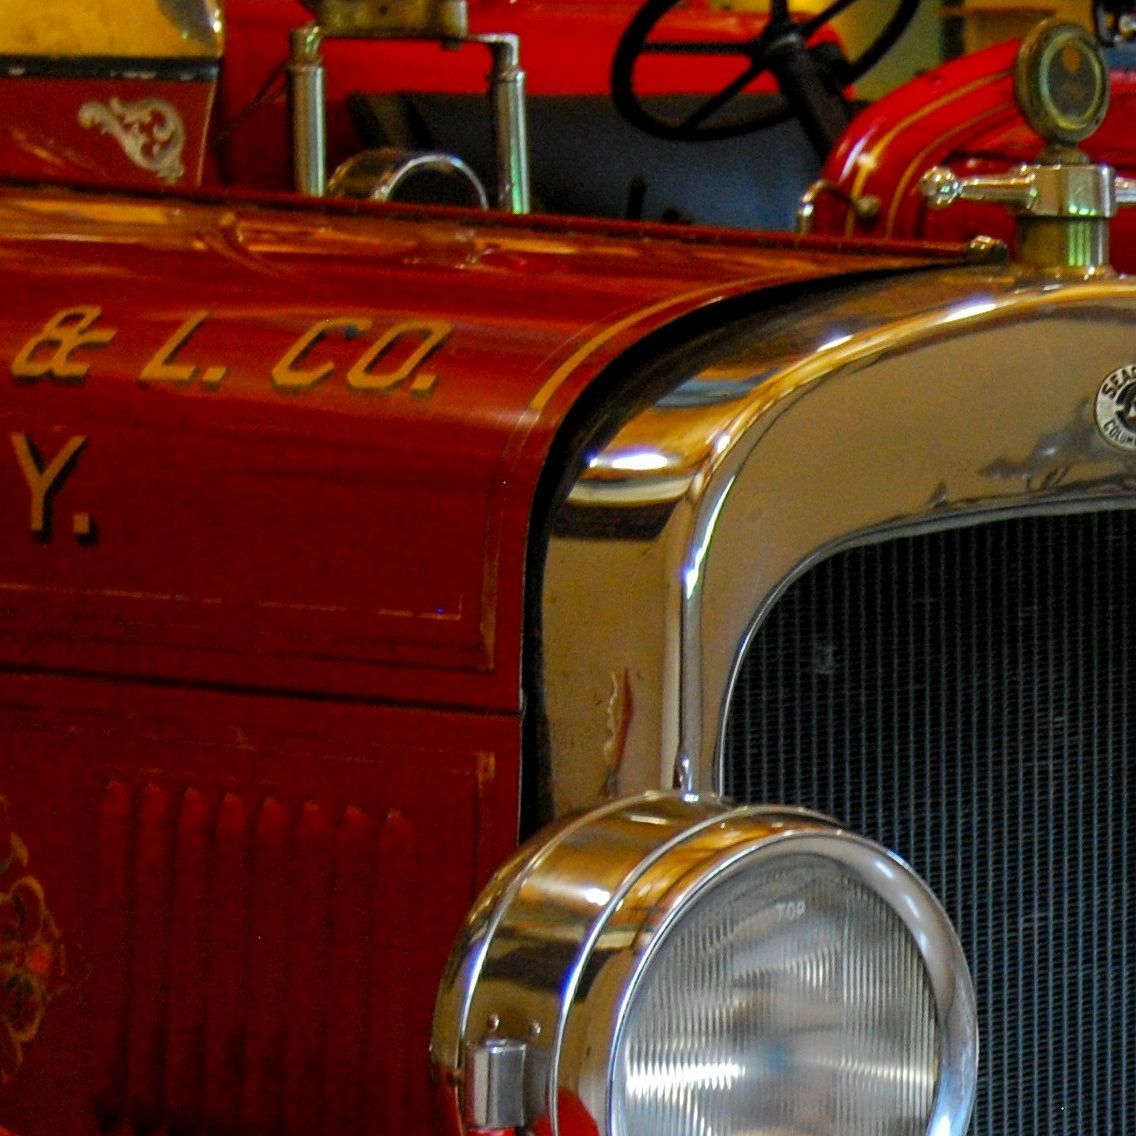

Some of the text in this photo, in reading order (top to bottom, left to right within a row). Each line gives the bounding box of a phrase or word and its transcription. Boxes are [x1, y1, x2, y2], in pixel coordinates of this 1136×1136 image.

[10, 304, 453, 393] & L. CO.
[10, 431, 95, 540] Y.
[775, 900, 807, 921] TOP
